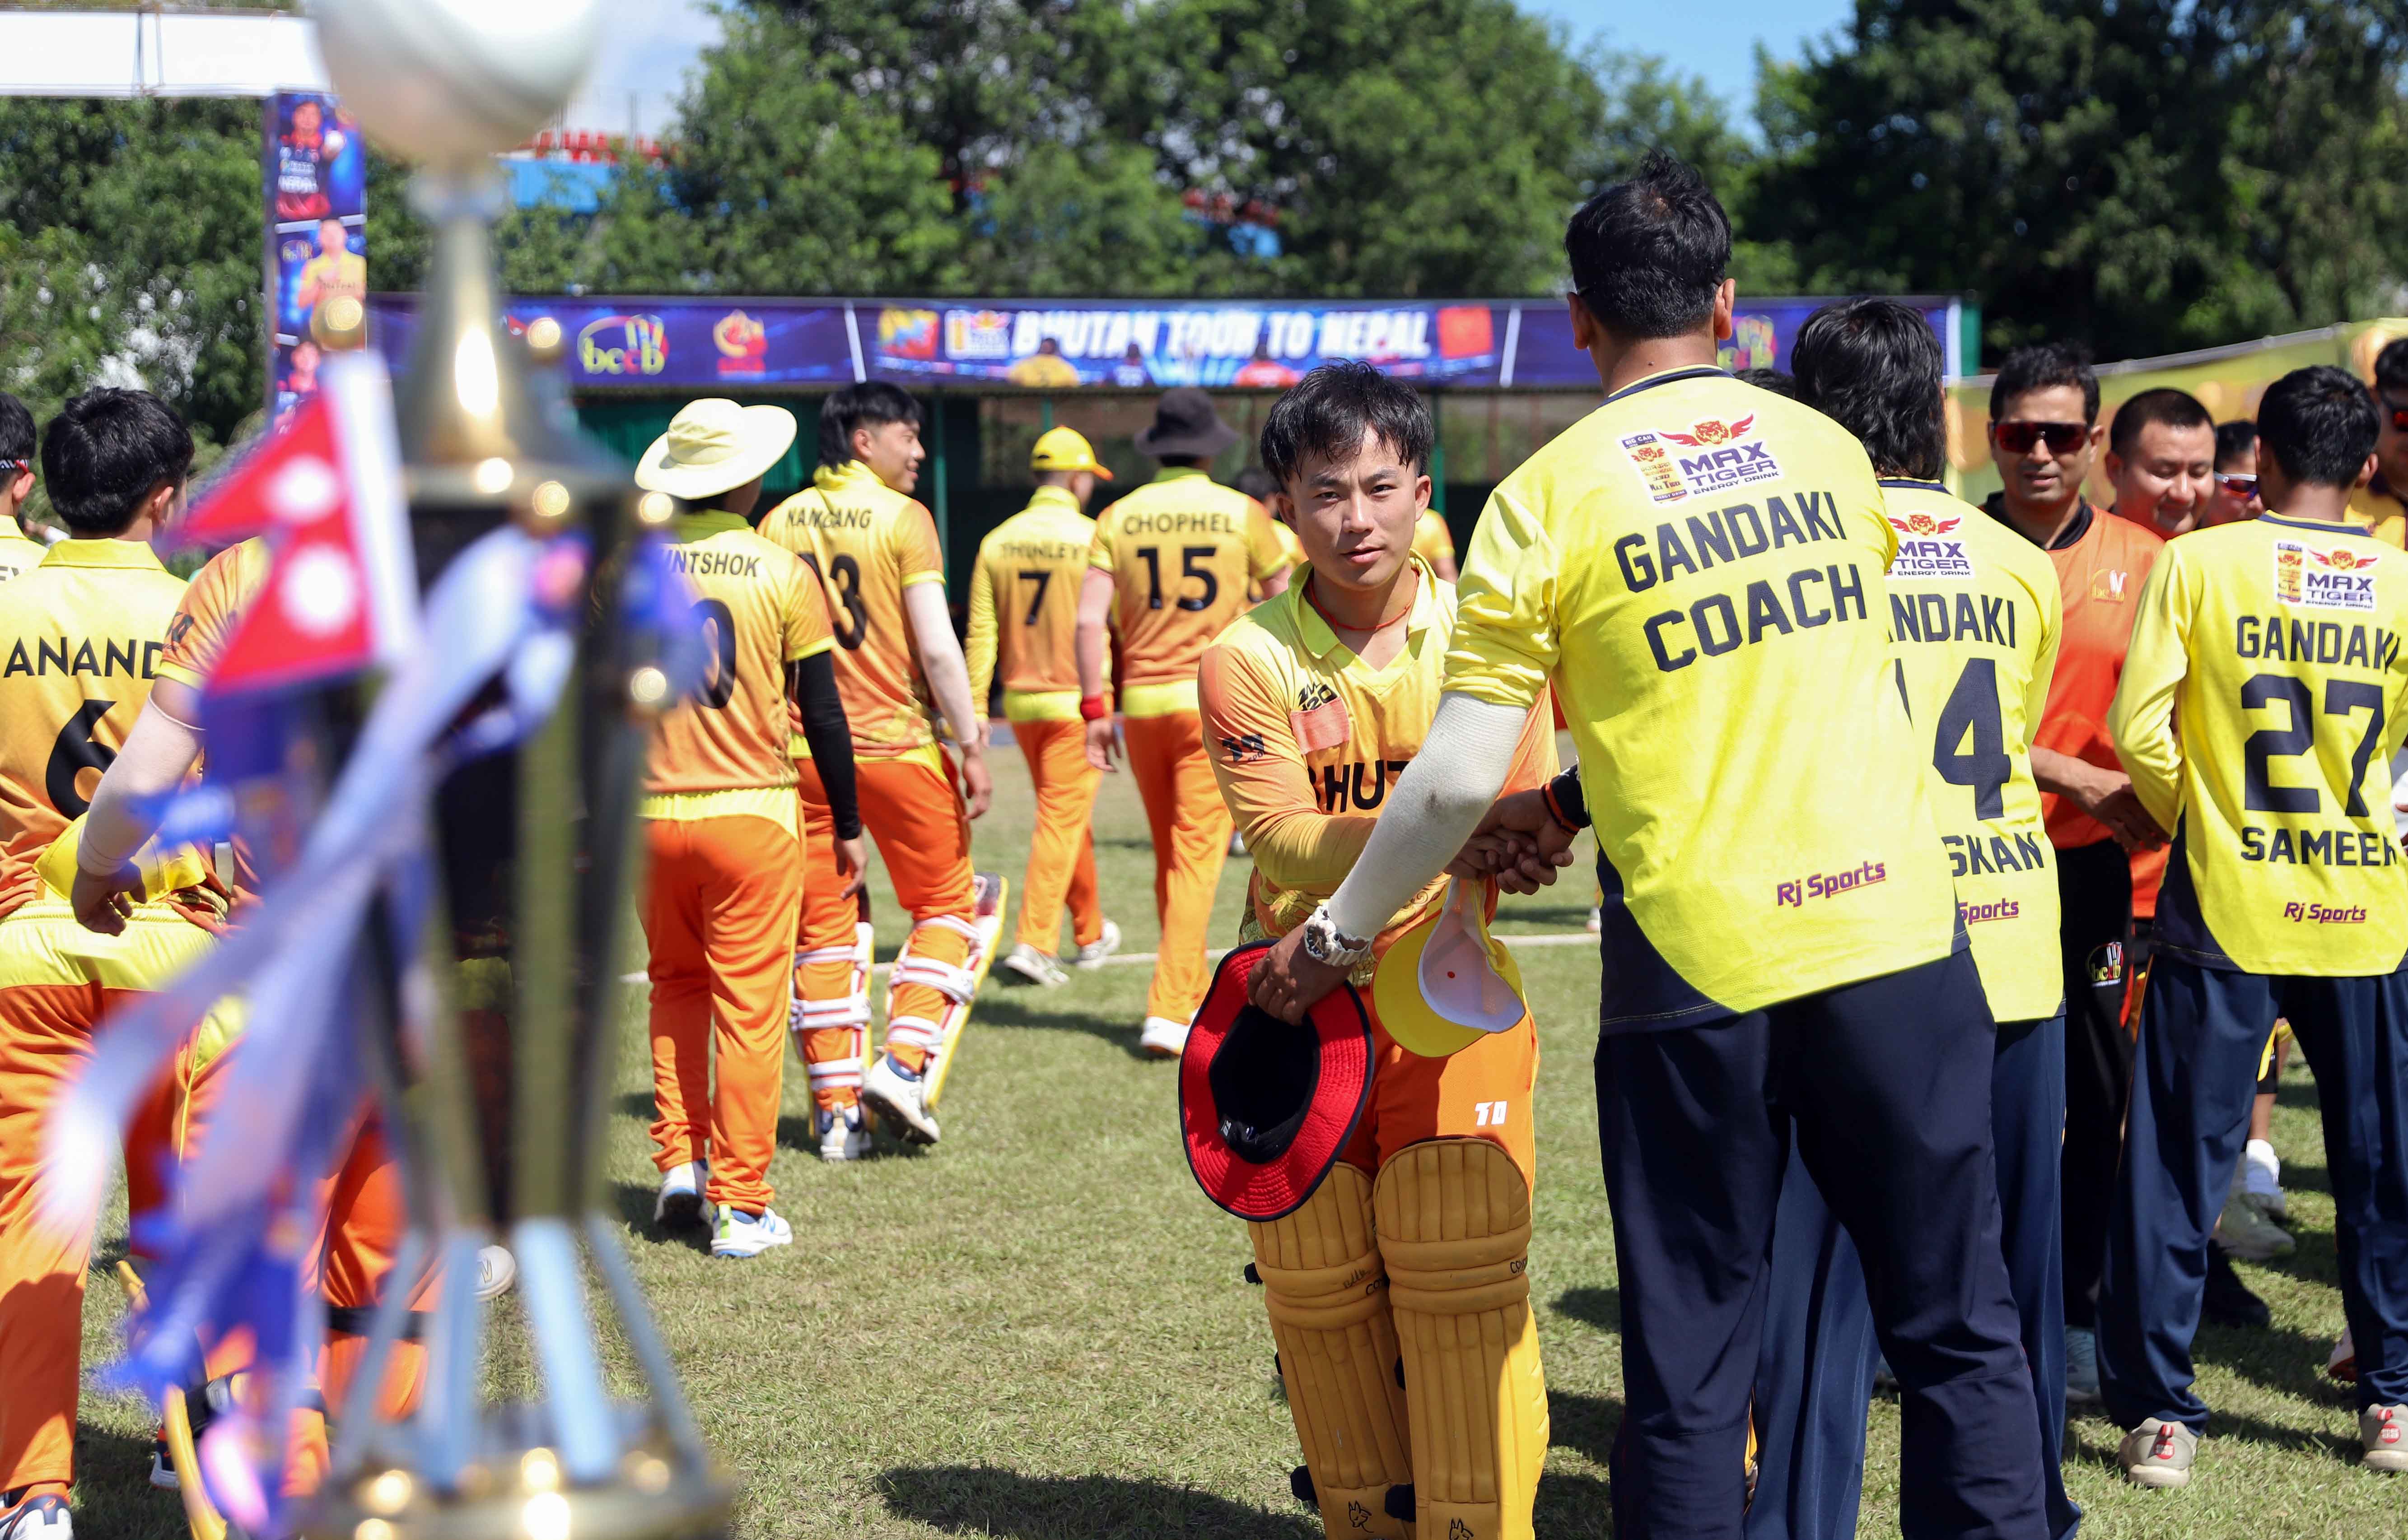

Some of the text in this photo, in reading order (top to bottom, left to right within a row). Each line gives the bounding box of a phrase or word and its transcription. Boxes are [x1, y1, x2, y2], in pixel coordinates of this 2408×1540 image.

[1266, 311, 1315, 359] TO
[1316, 312, 1432, 359] NEPAL
[1679, 441, 1769, 475] MAX
[1687, 459, 1777, 486] TIGER
[1693, 471, 1779, 494] ENERGY DRINK
[1124, 513, 1235, 536] CHOPHEL
[1614, 491, 1847, 593] GANDAKI
[1895, 558, 1970, 569] TIGER
[1896, 541, 1965, 558] MAX
[1137, 546, 1217, 611] 15
[2306, 588, 2374, 603] TIGER
[2307, 572, 2374, 592] MAX
[1019, 571, 1051, 626] 7
[1643, 563, 1867, 672] COACH
[4, 636, 164, 680] ANAND
[46, 698, 118, 821] 6
[2241, 674, 2385, 817] 27
[1777, 860, 1886, 907] Rj Sports
[2283, 901, 2367, 924] Rj Sports
